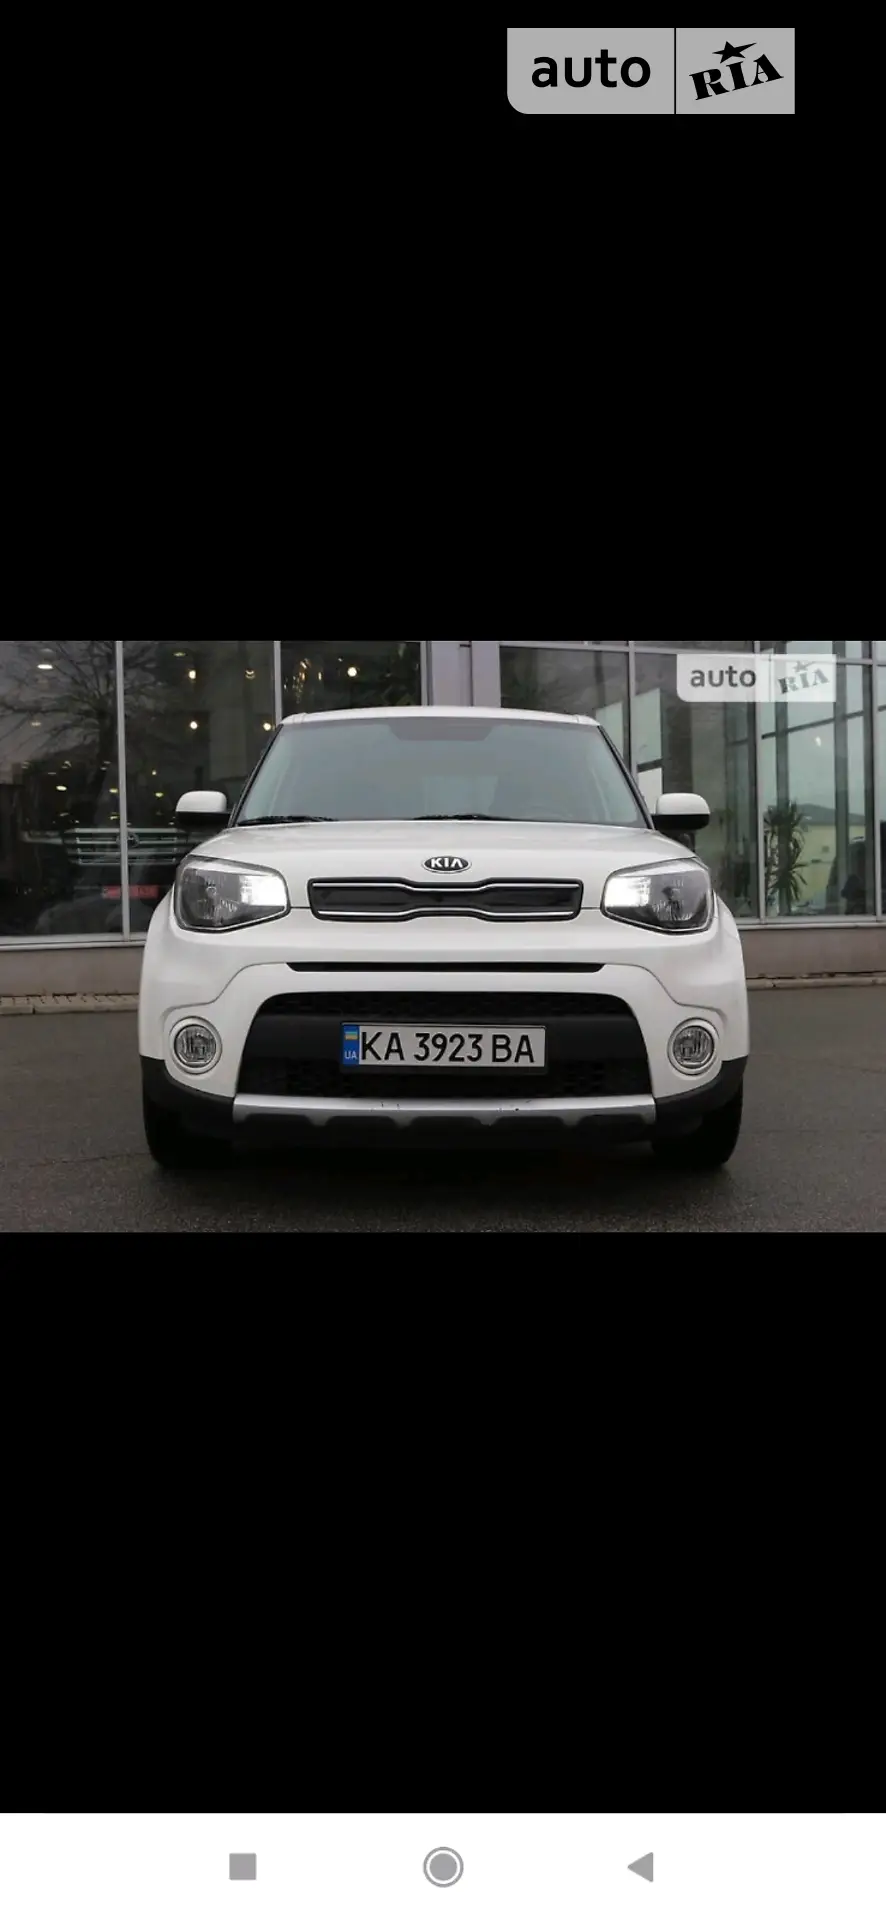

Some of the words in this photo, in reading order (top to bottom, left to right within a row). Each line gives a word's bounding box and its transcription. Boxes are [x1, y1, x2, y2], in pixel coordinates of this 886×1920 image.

[431, 857, 463, 868] KIA
[361, 1031, 405, 1061] KA
[413, 1033, 484, 1062] 3923
[491, 1033, 535, 1063] BA
[344, 1050, 358, 1060] UA
